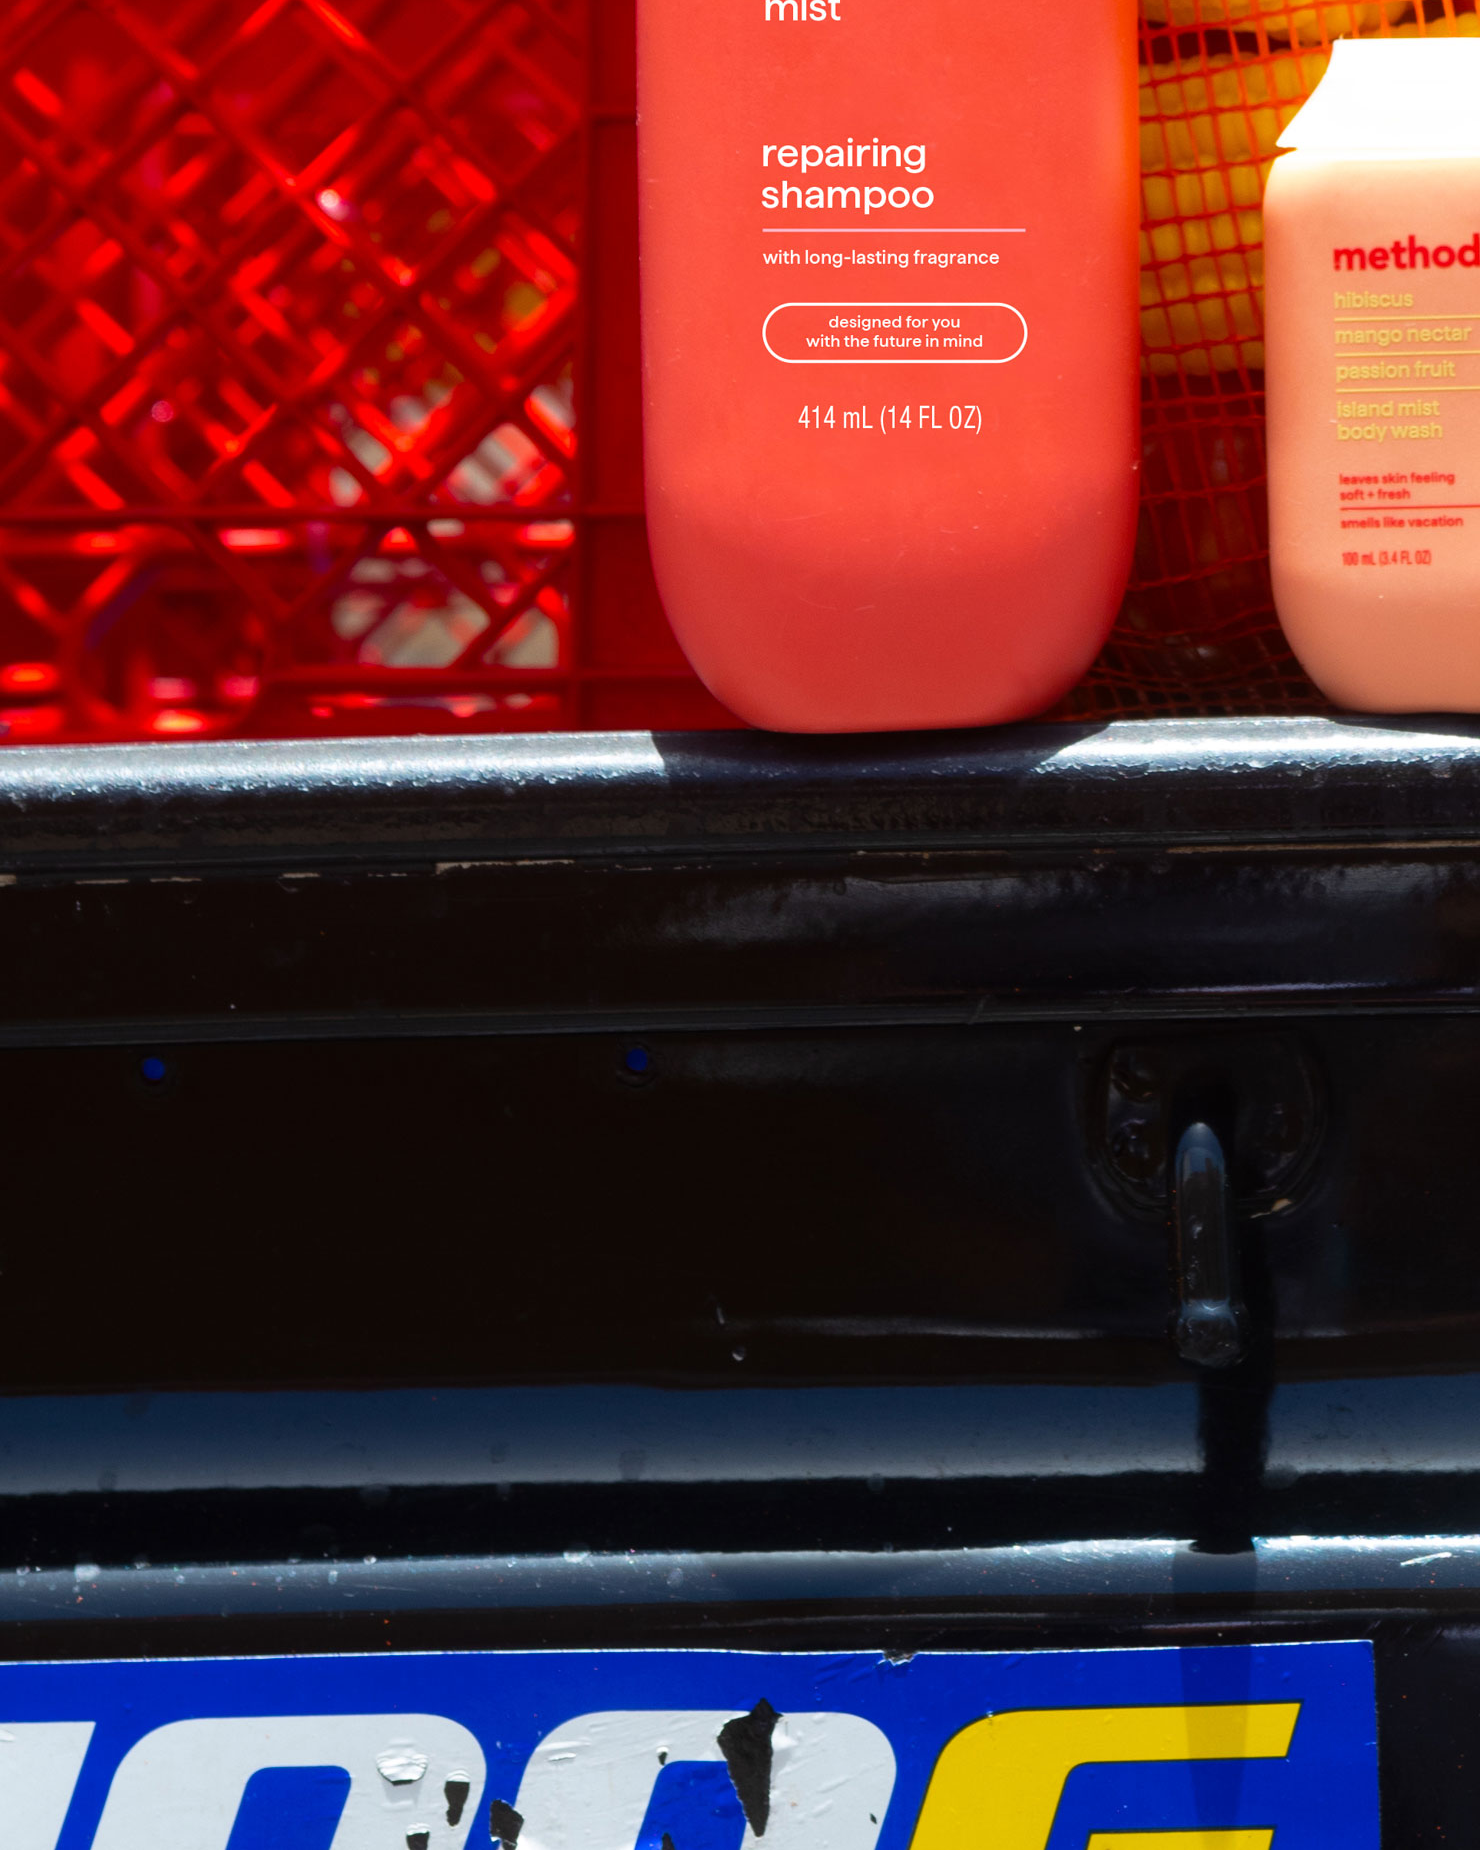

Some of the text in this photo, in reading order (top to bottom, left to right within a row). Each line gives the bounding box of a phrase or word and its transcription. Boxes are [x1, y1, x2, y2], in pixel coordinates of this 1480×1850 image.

[763, 138, 925, 173] repairing
[762, 181, 934, 214] shampoo
[763, 250, 999, 268] with long-lasting fragrance
[1334, 291, 1413, 310] hibiscus
[829, 315, 960, 331] designed for you
[806, 334, 982, 347] with the future in mind
[1335, 326, 1472, 348] mango nectar
[1336, 360, 1455, 382] passion fruit
[1337, 400, 1440, 419] island mist
[798, 406, 981, 434] 414 mL (14 FL OZ)
[1337, 422, 1443, 442] body wash
